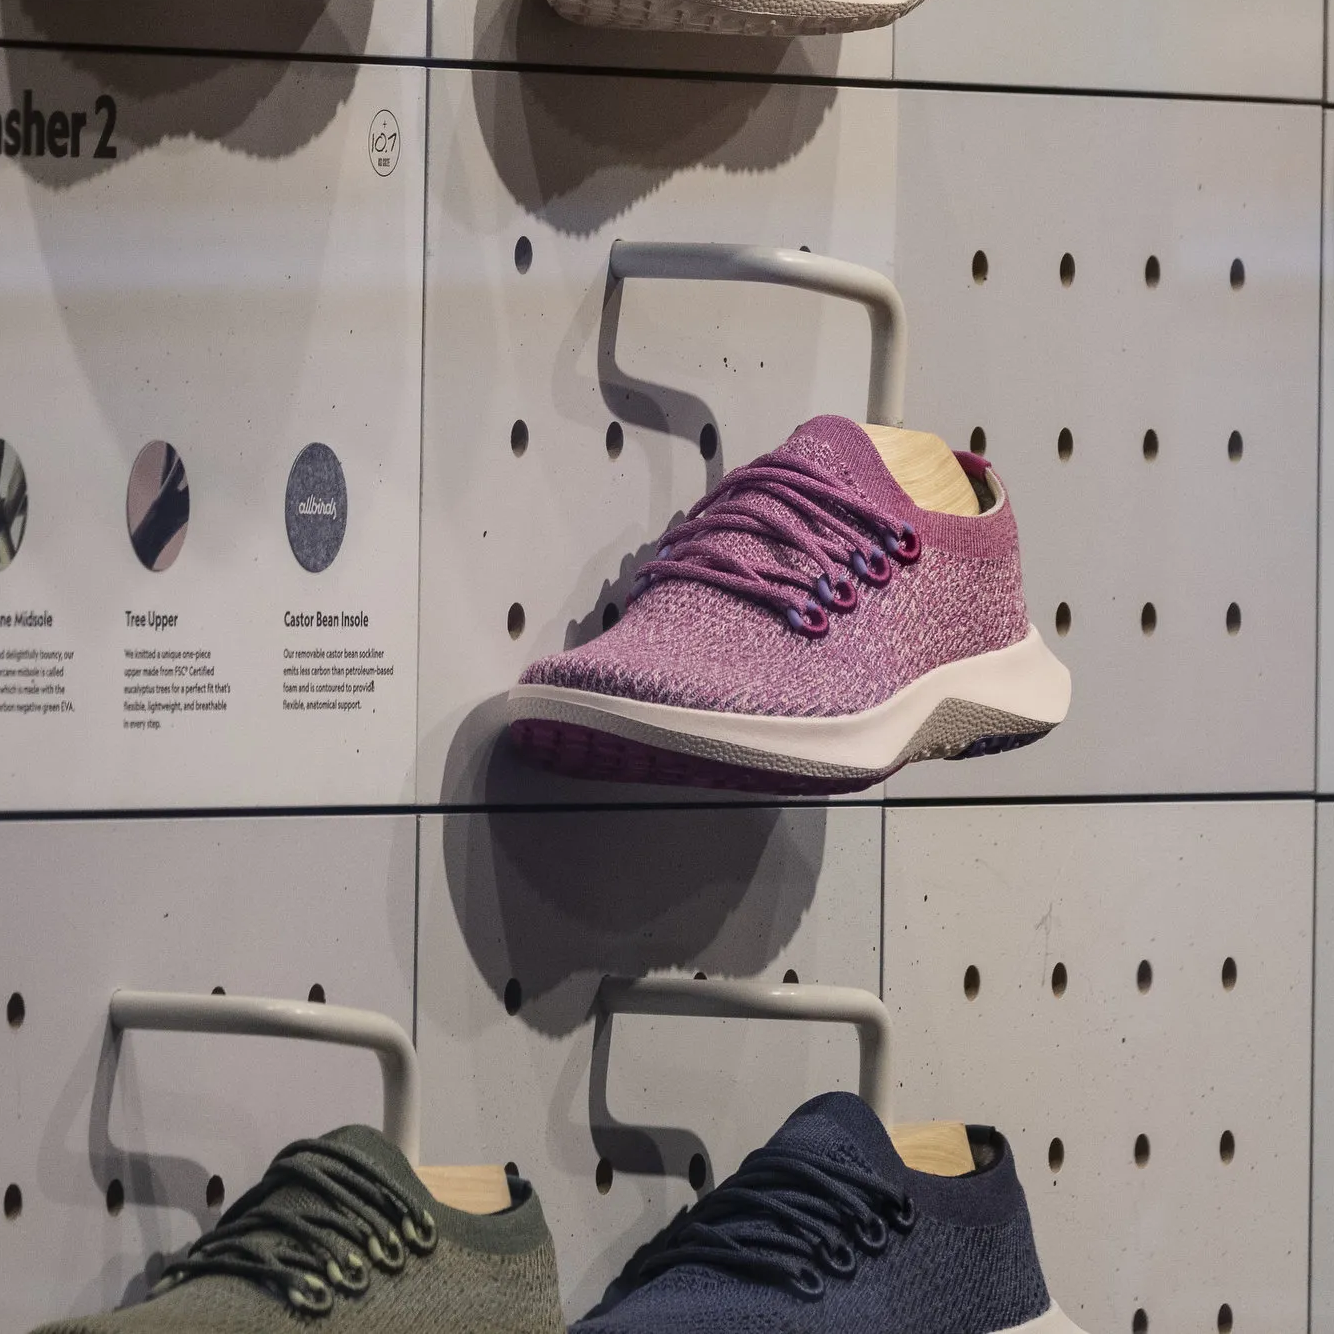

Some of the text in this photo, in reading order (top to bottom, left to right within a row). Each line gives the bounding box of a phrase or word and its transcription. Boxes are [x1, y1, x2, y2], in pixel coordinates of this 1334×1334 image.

[95, 92, 118, 159] 2
[298, 493, 337, 520] allbirds
[14, 610, 53, 627] Midsole
[125, 611, 178, 631] Tree Upper
[284, 611, 369, 627] Castor Bean Insole
[283, 649, 384, 658] Our removable castor bean sockliner
[189, 667, 215, 676] Certified
[283, 665, 394, 678] emits less carbon than petroleum-based
[55, 685, 65, 694] the
[171, 683, 180, 693] for
[185, 683, 206, 695] perfect
[283, 682, 298, 692] foam
[298, 682, 309, 692] and
[310, 682, 315, 692] is
[316, 682, 345, 692] contoured
[346, 684, 352, 692] to
[183, 701, 194, 711] and
[196, 701, 227, 711] breathable
[282, 699, 362, 711] flexible, anatomical support.
